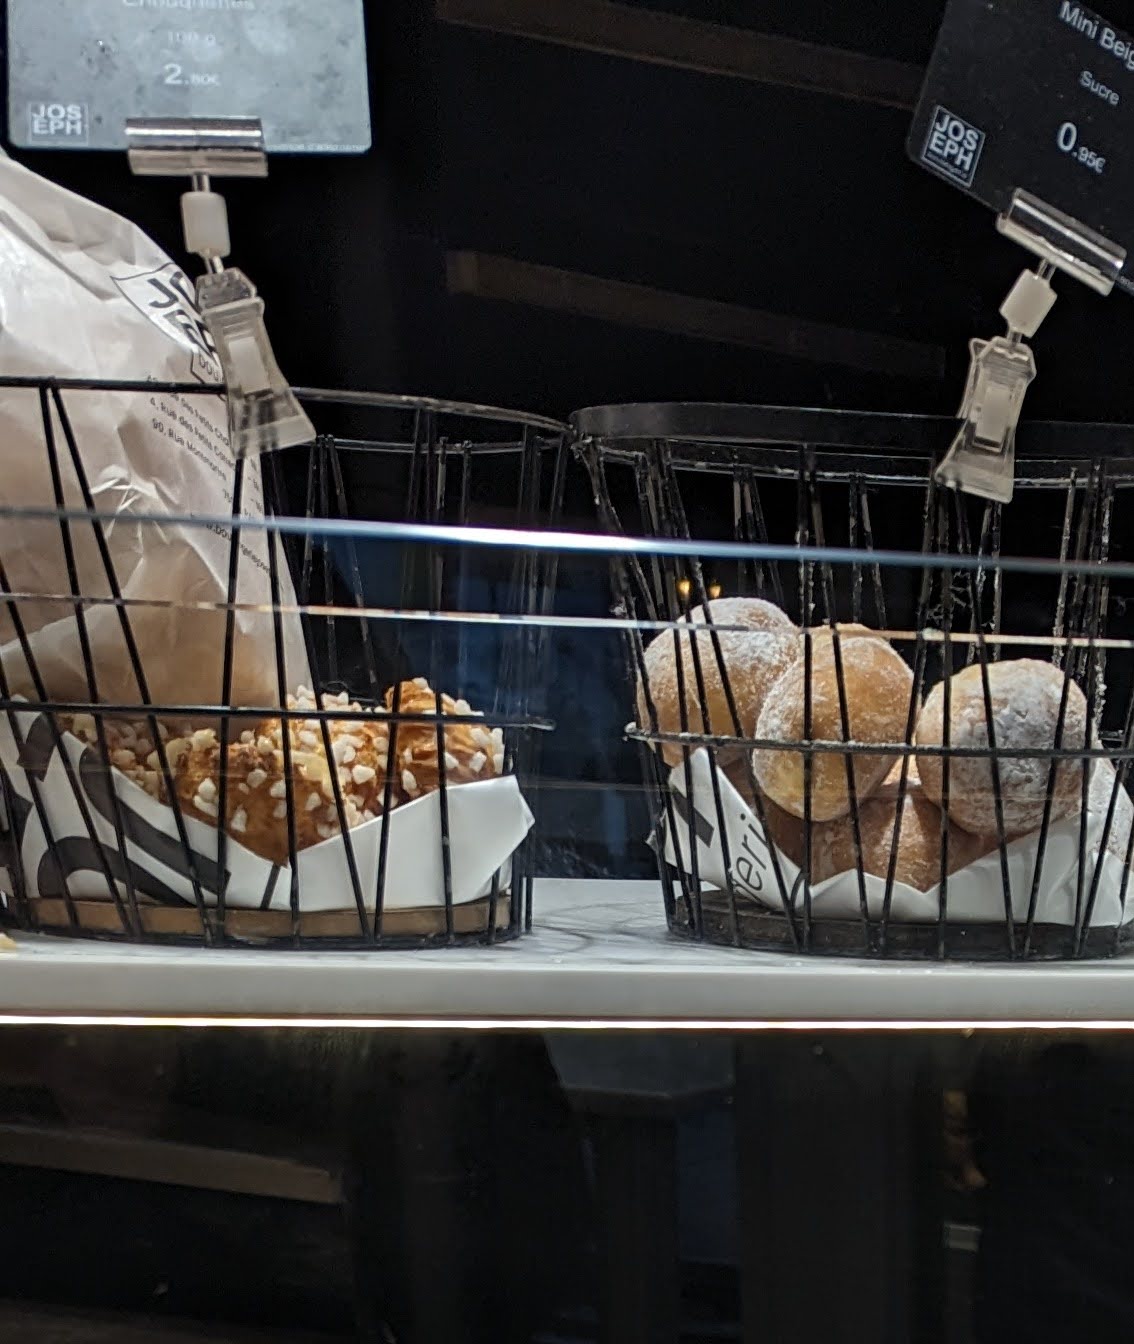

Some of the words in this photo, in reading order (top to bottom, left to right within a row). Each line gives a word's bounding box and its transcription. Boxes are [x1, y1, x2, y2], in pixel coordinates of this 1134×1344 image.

[1060, 0, 1098, 40] Mini
[1080, 70, 1120, 105] Sucre
[31, 103, 83, 120] JOS
[31, 119, 83, 135] EPH
[935, 115, 979, 151] JOS
[1057, 121, 1106, 174] 0.95€
[929, 132, 973, 172] EPH
